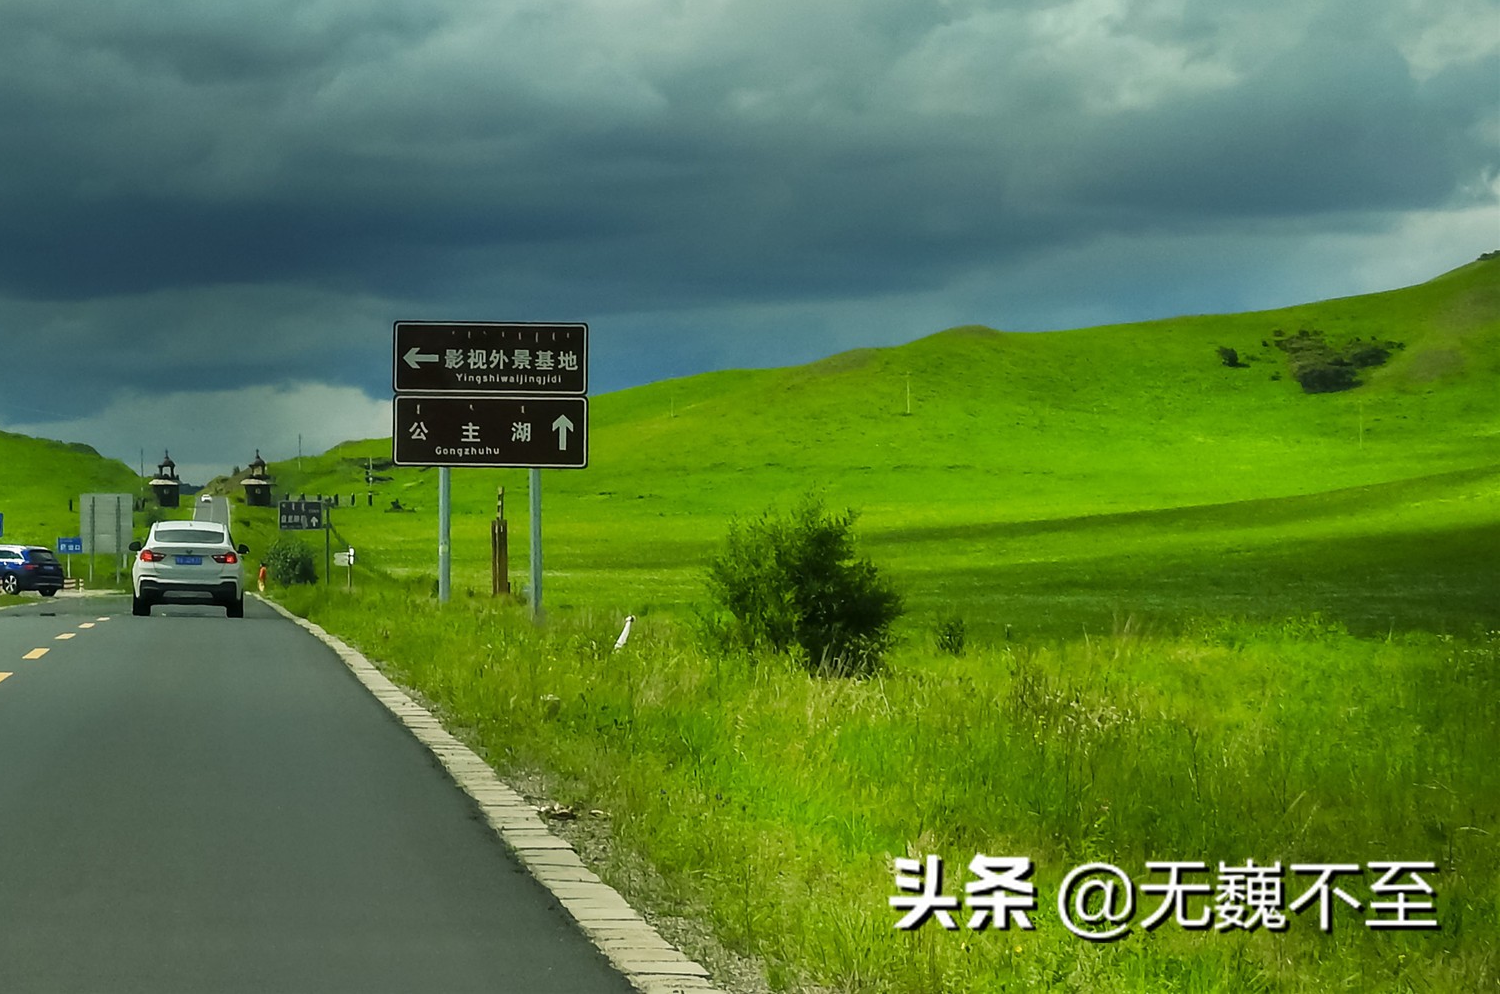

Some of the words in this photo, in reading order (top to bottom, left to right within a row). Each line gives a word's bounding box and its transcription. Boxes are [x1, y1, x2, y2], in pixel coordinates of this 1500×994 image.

[444, 348, 579, 371] 影视外景基地
[455, 373, 562, 385] Yingshiwaijingjidi
[408, 421, 532, 442] 公主湖
[435, 446, 500, 457] Gongzhuhu
